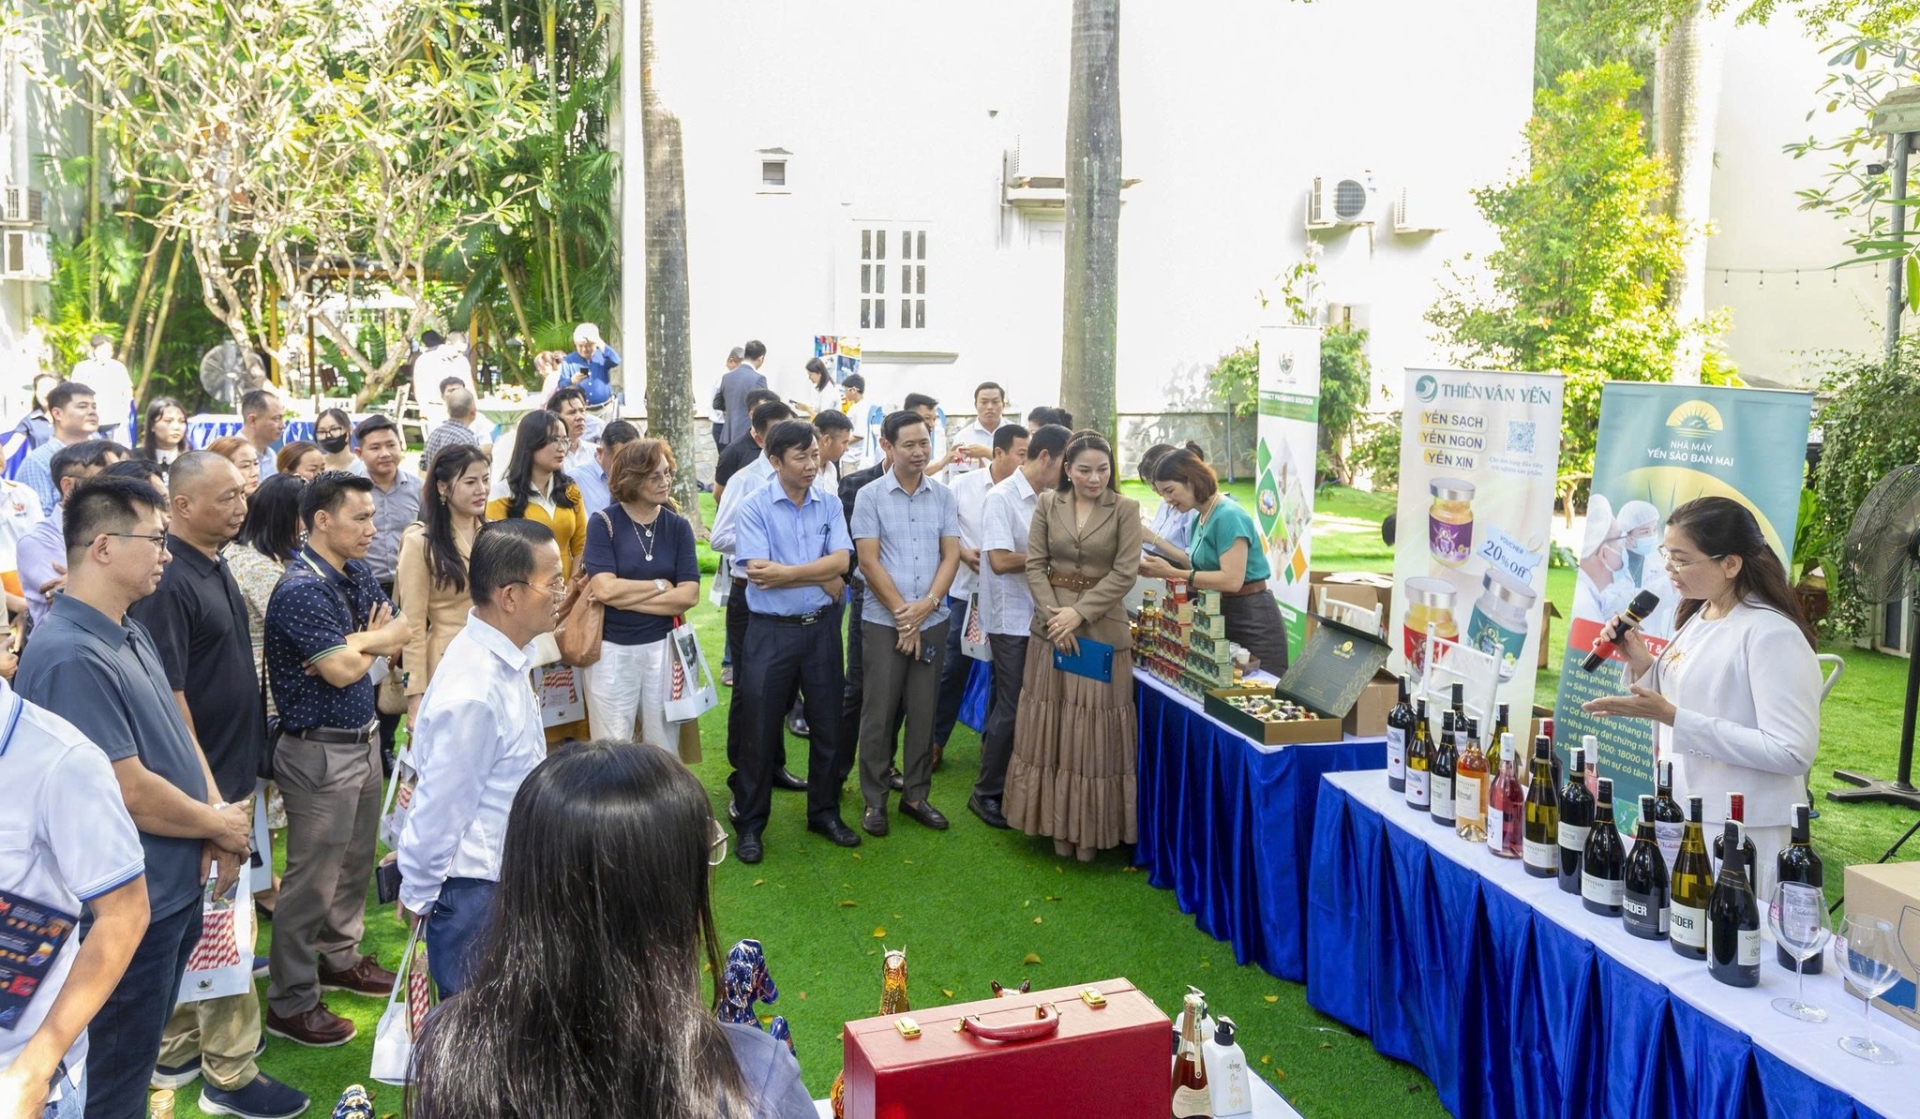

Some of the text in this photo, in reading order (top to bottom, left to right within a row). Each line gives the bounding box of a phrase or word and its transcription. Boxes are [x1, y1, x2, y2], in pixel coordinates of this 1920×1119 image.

[1442, 382, 1551, 404] THIÊN VÂN YẾN
[1425, 410, 1484, 430] YẾN SẠCH
[1422, 430, 1482, 449] YẾN NGON
[1670, 440, 1713, 452] NHÀ MÁY
[1428, 450, 1473, 470] YẾN XỊN
[1647, 447, 1667, 459] YẾN
[1691, 454, 1714, 464] BAN
[1716, 456, 1734, 467] MAI
[1483, 540, 1509, 568] 20%
[1500, 535, 1524, 554] VOUCHER
[1576, 670, 1588, 680] Sản
[1590, 676, 1612, 688] phẩm
[1568, 718, 1582, 730] Nhà
[1584, 723, 1600, 736] máy
[1600, 730, 1612, 741] đạt
[1613, 734, 1636, 750] chứng
[1618, 722, 1642, 738] khang
[1618, 749, 1640, 764] 18000
[1622, 764, 1632, 774] có
